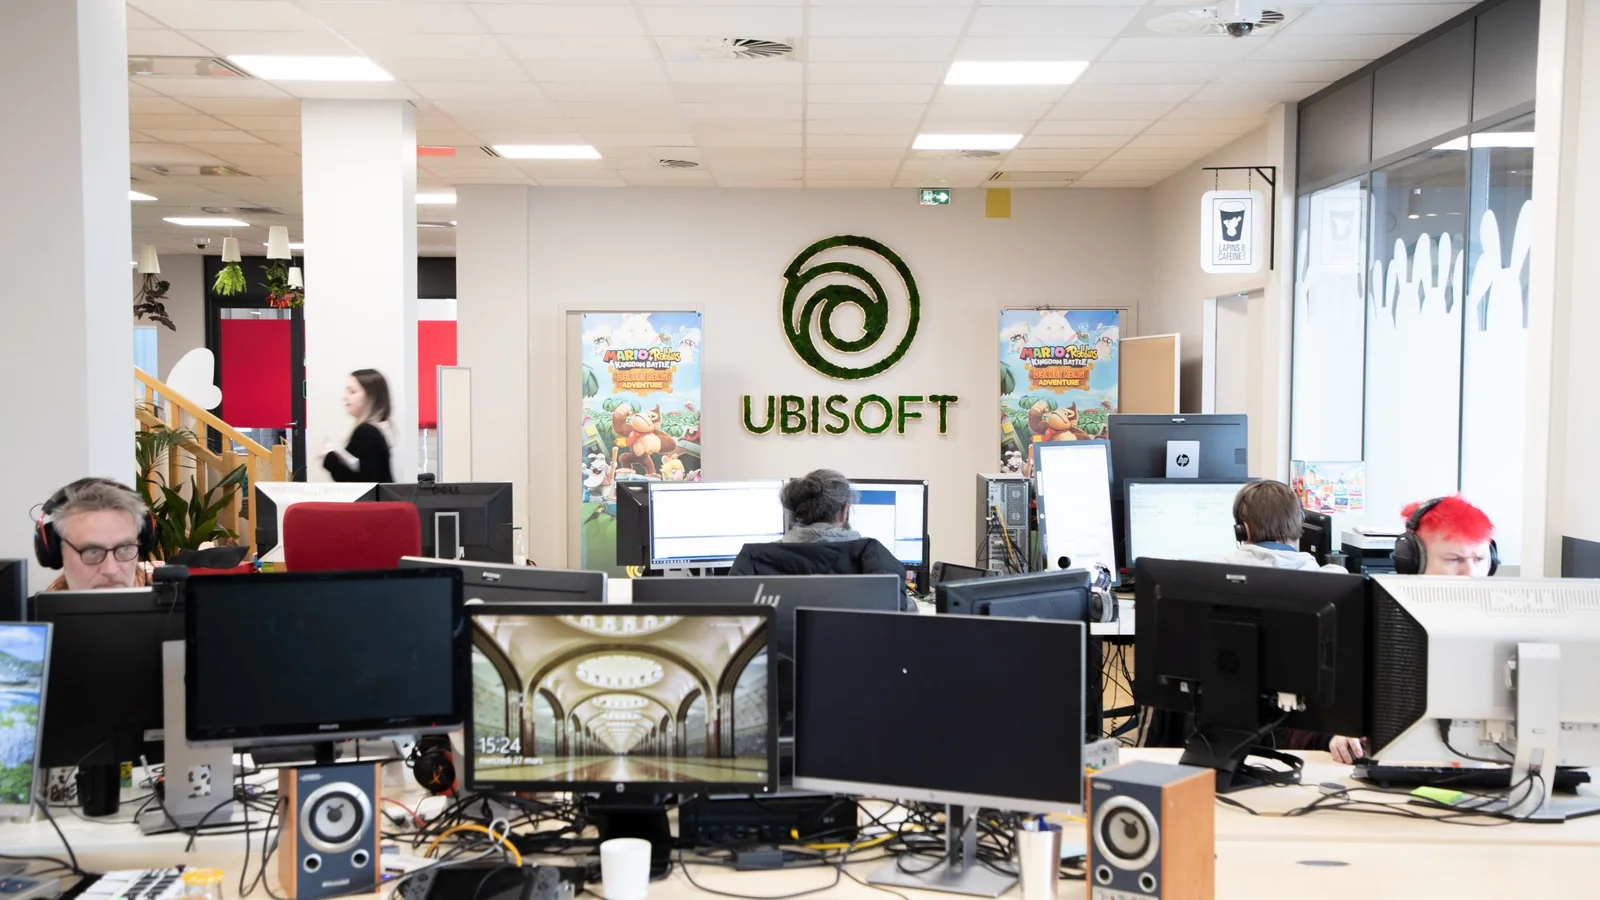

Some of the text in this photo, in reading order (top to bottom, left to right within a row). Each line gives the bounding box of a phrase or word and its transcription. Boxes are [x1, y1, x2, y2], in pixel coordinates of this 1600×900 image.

[1219, 244, 1240, 252] LAPINS
[604, 348, 649, 362] MARIO
[1021, 346, 1065, 359] MARIO
[646, 361, 671, 369] BATTLE
[1031, 358, 1088, 366] KINGDOM BATTLE
[1033, 369, 1085, 379] DONKEY KONG
[741, 393, 959, 436] UBISOFT
[478, 736, 522, 754] 15:24
[513, 756, 523, 765] 27
